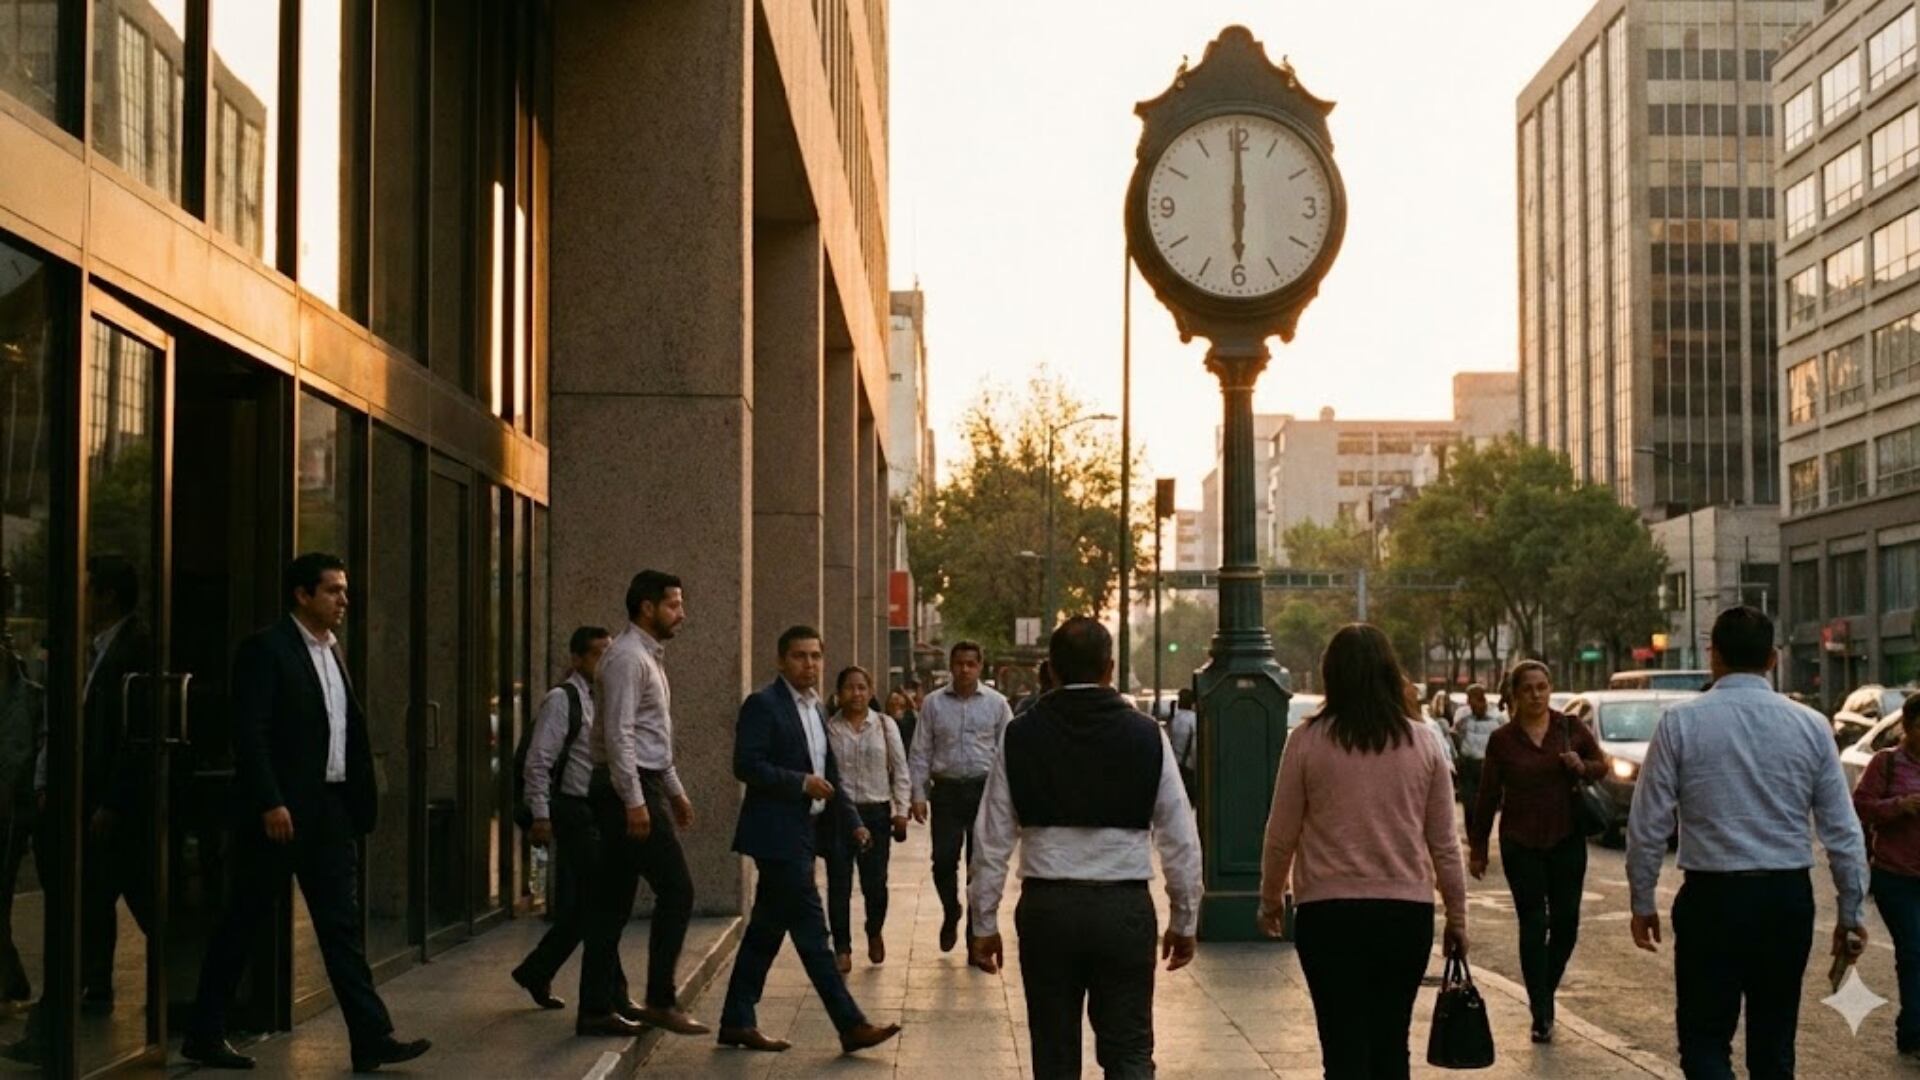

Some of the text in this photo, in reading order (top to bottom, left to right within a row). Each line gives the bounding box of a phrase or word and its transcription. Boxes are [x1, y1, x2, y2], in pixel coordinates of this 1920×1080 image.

[1228, 128, 1250, 152] 12
[1160, 196, 1175, 218] 9
[1302, 197, 1317, 220] 3
[1231, 265, 1246, 287] 6
